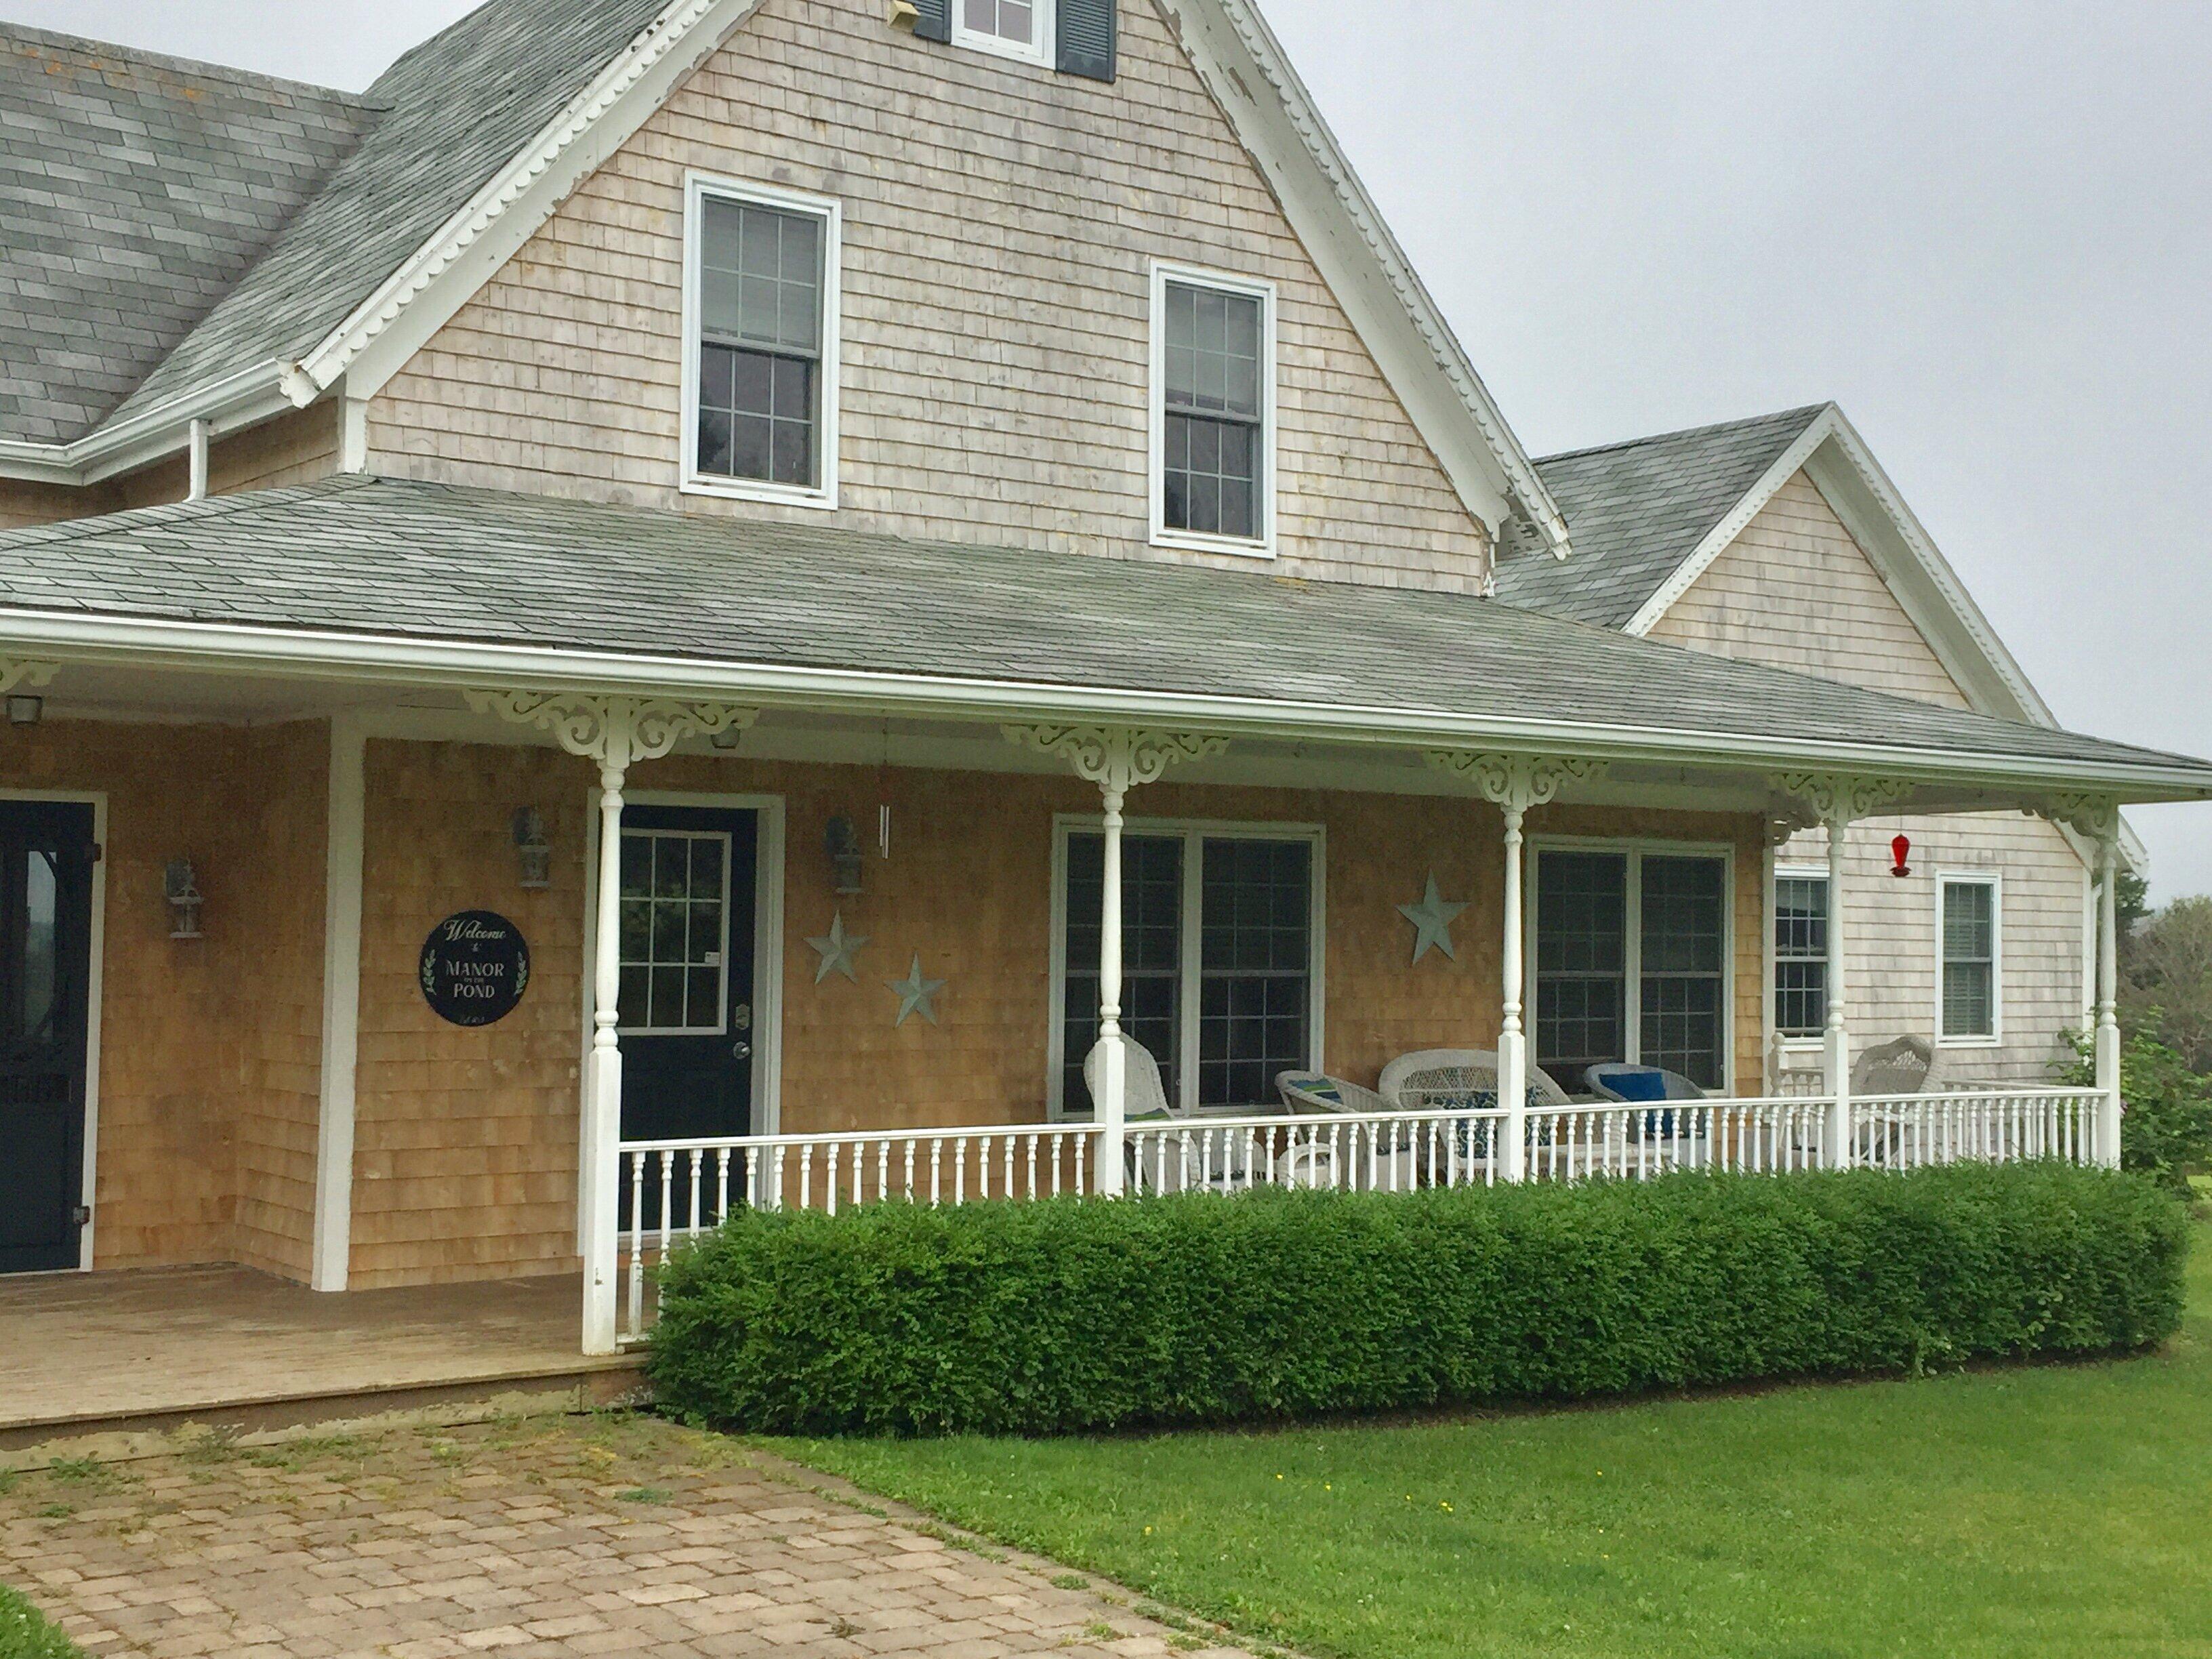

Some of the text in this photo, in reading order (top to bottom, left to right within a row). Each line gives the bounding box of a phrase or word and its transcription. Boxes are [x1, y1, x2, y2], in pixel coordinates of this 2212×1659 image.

[444, 919, 506, 941] Welcome
[446, 959, 504, 977] MANOR
[453, 982, 495, 998] POND
